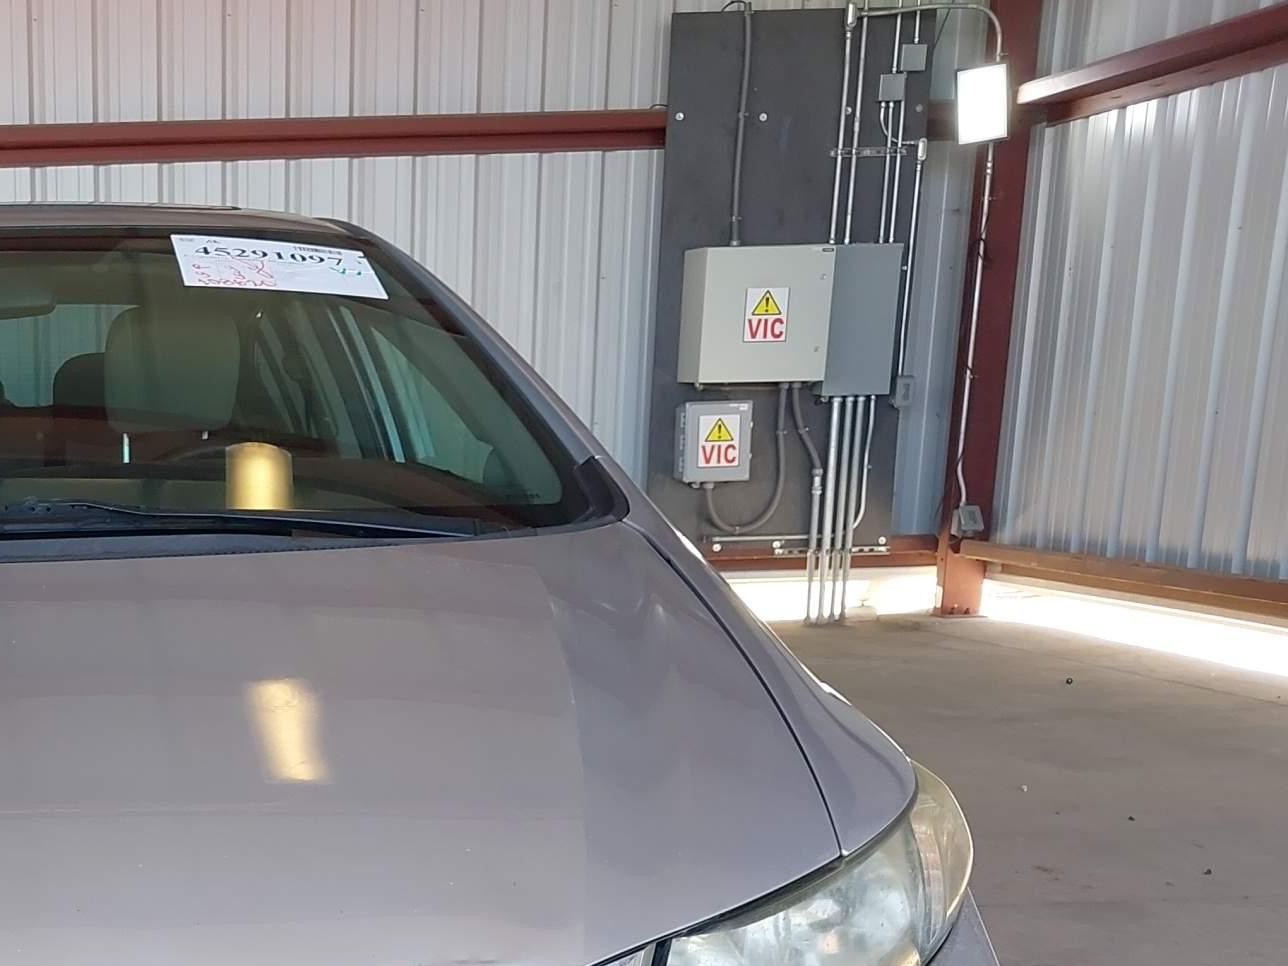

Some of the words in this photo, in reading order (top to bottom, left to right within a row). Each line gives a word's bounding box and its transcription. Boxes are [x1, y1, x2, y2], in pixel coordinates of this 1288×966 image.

[194, 246, 343, 266] 45291097
[748, 318, 784, 338] VIC
[702, 444, 737, 464] VIC
